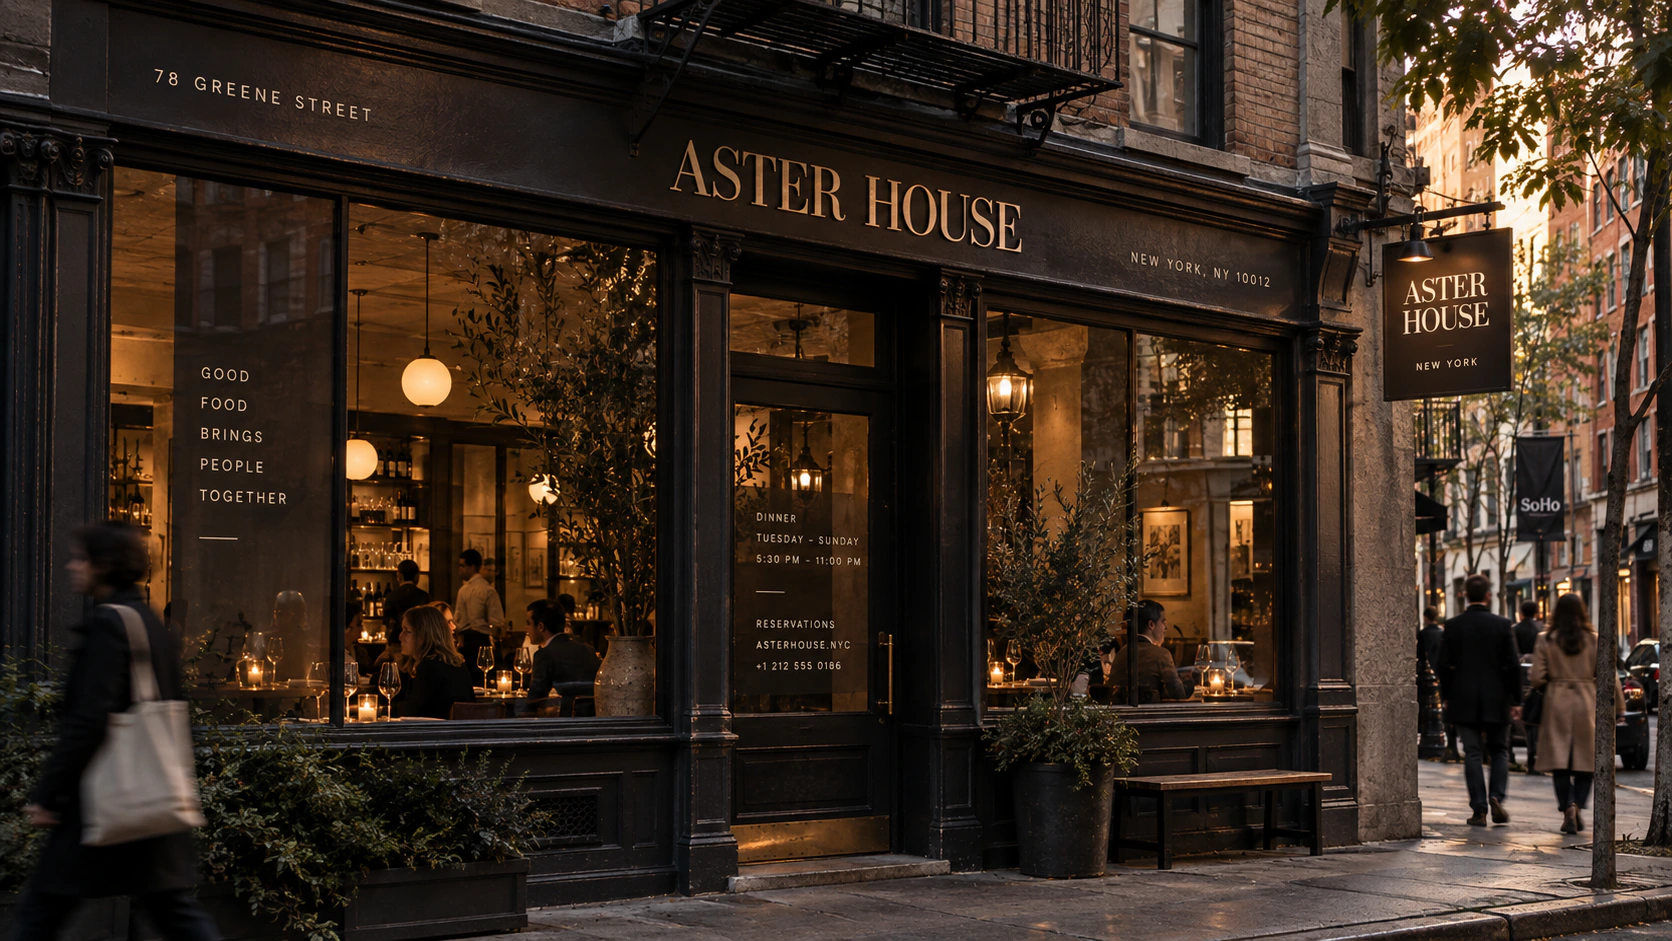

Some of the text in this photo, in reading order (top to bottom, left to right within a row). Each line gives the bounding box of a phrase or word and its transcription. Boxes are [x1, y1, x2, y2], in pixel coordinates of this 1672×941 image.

[154, 68, 372, 122] 78 GREENE STREET
[670, 139, 1023, 253] ASTER HOUSE
[1130, 251, 1270, 288] NEW YORK, NY 10012
[1403, 272, 1488, 306] ASTER
[1402, 299, 1490, 335] HOUSE
[1416, 357, 1478, 371] NEW YORK
[201, 366, 249, 383] GOOD
[201, 396, 247, 412] FOOD
[200, 427, 263, 443] BRINGS
[200, 457, 263, 474] PEOPLE
[200, 488, 287, 505] TOGETHER
[1520, 497, 1561, 512] SoHo
[756, 512, 796, 523] DINNER
[756, 533, 804, 544] TUESDAY
[818, 536, 859, 546] SUNDAY
[756, 554, 780, 564] 5:30
[785, 555, 800, 564] PM
[815, 556, 842, 566] 11:00
[847, 557, 861, 566] PM
[756, 619, 835, 629] RESERVATIONS
[756, 640, 851, 650] ASTERHOUSE.NYC
[756, 661, 842, 671] +1 212 555 0186
